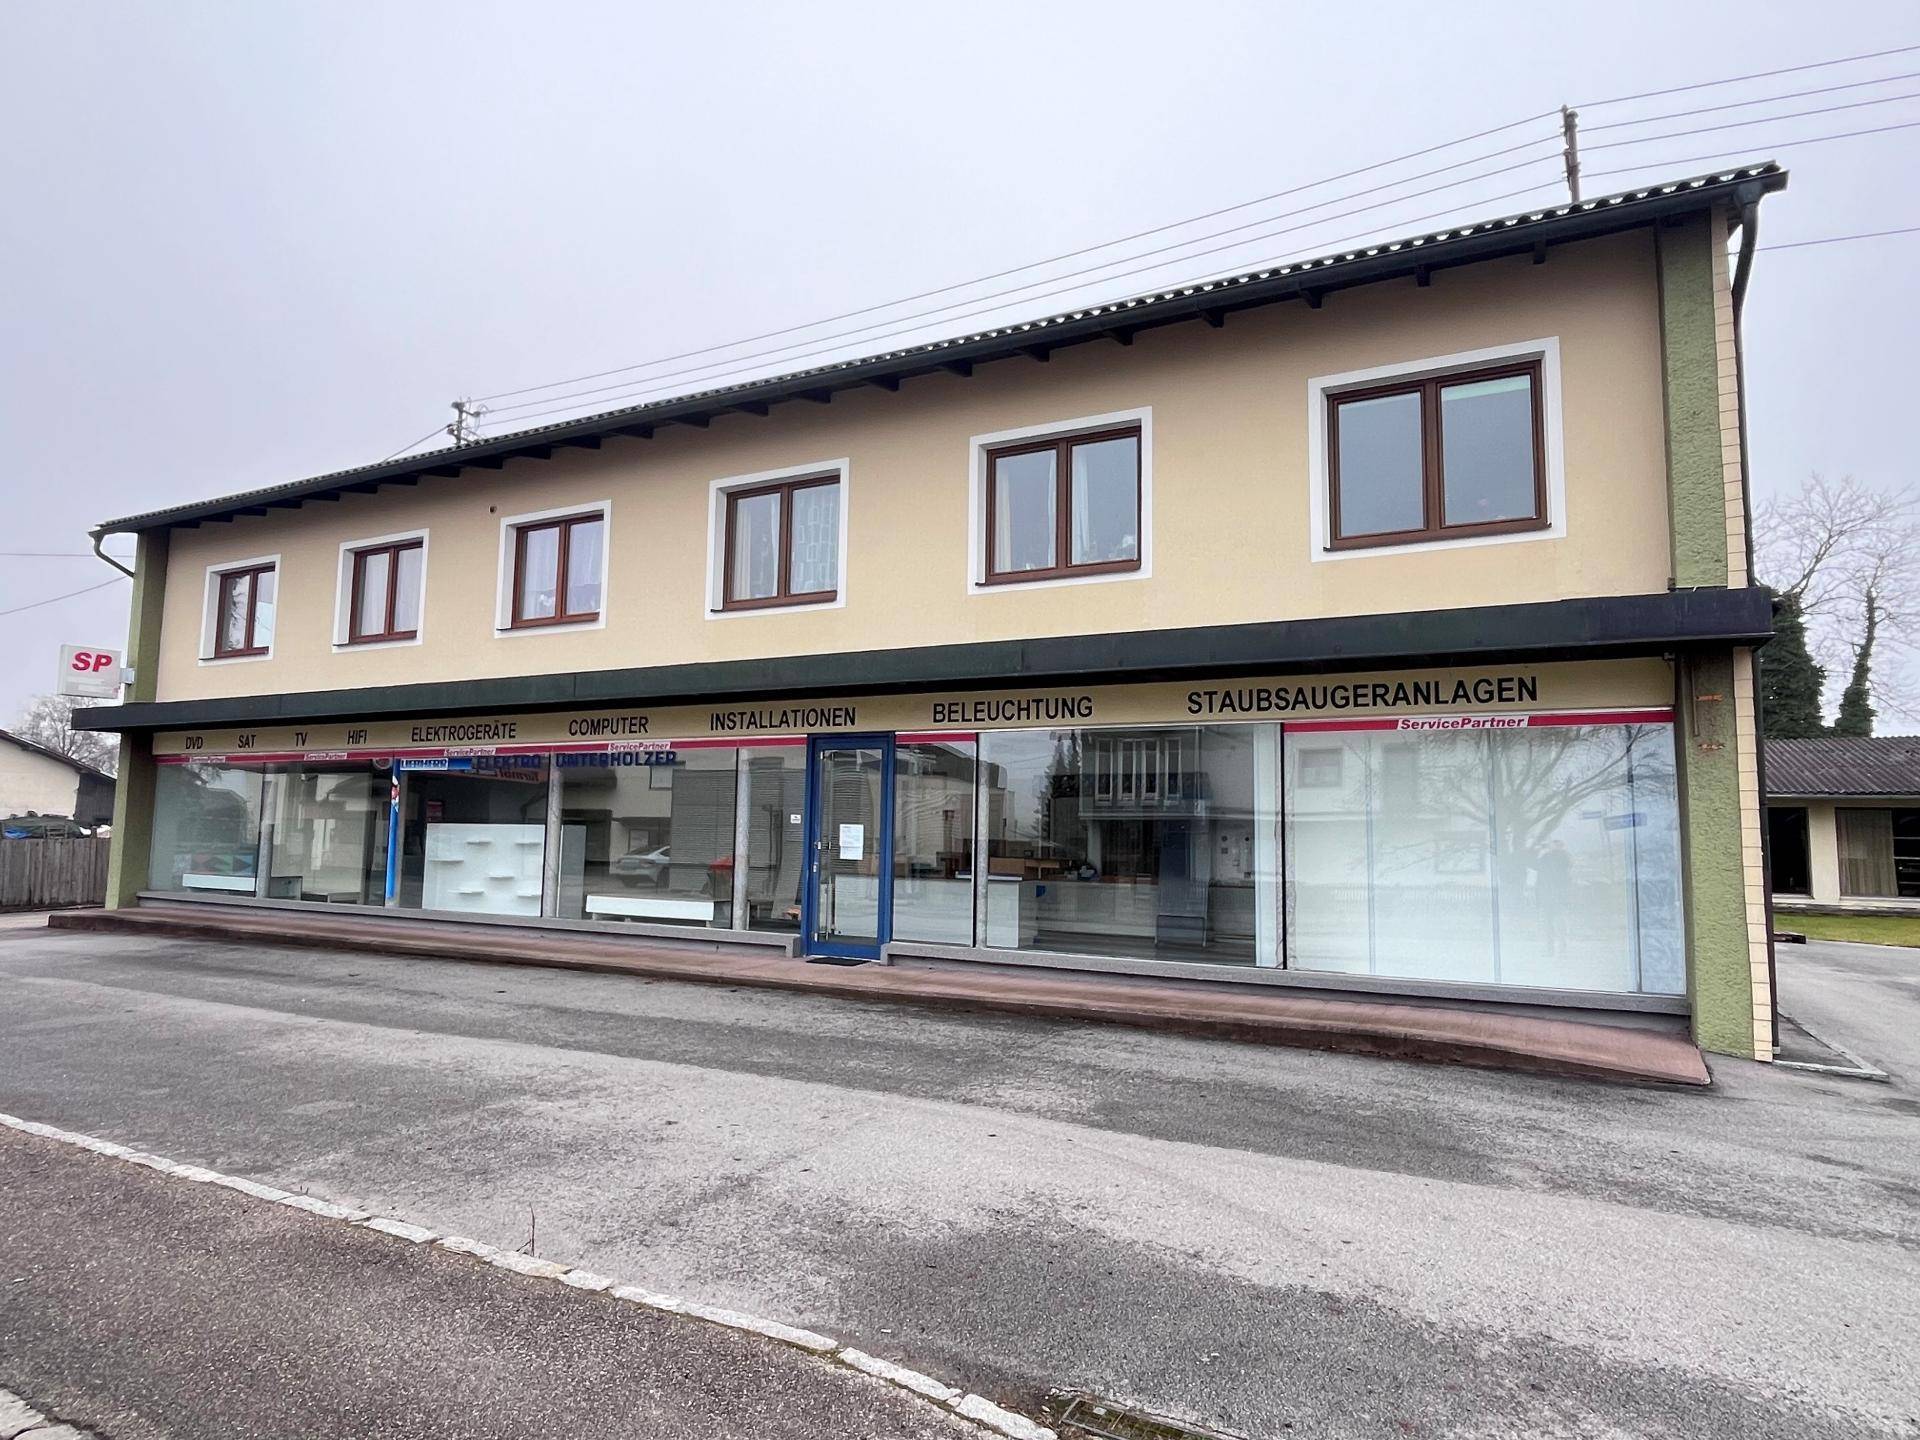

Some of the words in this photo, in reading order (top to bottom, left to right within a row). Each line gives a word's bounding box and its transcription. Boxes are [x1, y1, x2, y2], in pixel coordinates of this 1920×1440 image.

[72, 652, 112, 672] SP
[1187, 676, 1538, 715] STAUBSAUGERANLAGEN
[932, 695, 1093, 724] BELEUCHTUNG
[568, 716, 649, 736] COMPUTER
[710, 707, 857, 731] INSTALLATIONEN
[1400, 717, 1525, 730] ServicePartner
[295, 732, 308, 747] TV
[347, 729, 367, 745] HIFI
[411, 720, 517, 743] ELEKTROGERÄTE
[185, 736, 204, 750] DVD
[238, 734, 256, 749] SAT
[609, 742, 669, 752] ServicePartner
[445, 748, 495, 756] ServicePartner
[477, 755, 541, 770] ELEKTRO
[555, 751, 677, 768] UNTERHOLZER
